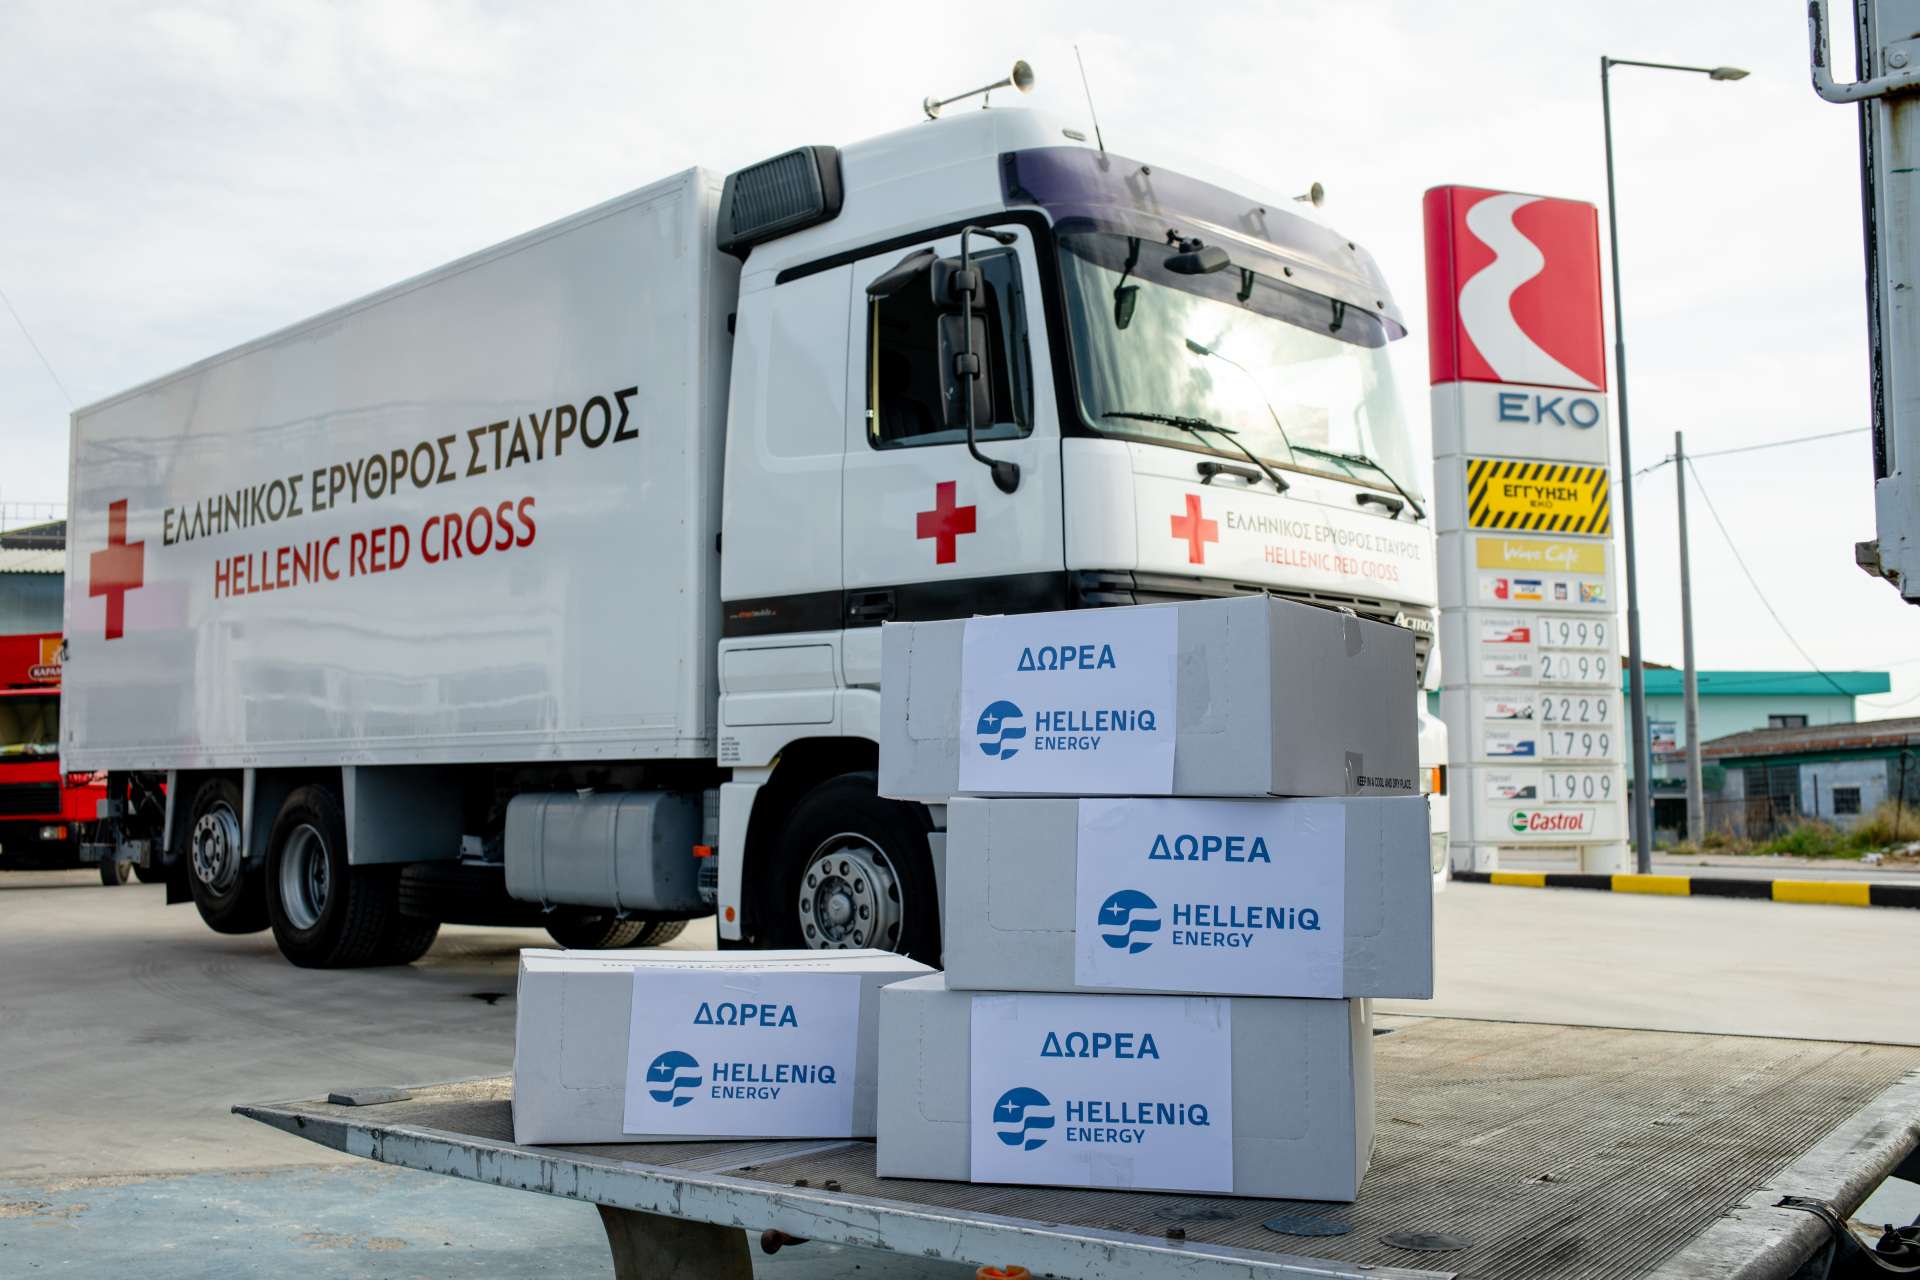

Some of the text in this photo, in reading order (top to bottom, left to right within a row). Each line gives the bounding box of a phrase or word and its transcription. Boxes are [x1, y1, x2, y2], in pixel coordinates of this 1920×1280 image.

[1499, 392, 1599, 429] EKO
[163, 385, 640, 547] ΕΛΛΗΝΙΚΟΣ ΕΡΥΘΡΟΣ ΣΤΑΥΡΟΣ
[1503, 484, 1578, 502] ΕΓΓΥΗΣΗ
[214, 494, 537, 600] HELLENIC RED CROSS
[1227, 511, 1421, 561] ΕΛΛΗΝΙΚΟΣ ΕΡΥΘΡΟΣ ΣΤΑΥΡΟΣ
[1264, 545, 1399, 582] HELLENIC RED CROSS
[1017, 644, 1116, 672] ΔΩΡΕΑ
[1035, 710, 1157, 732] HELLENiQ
[1034, 736, 1101, 751] ENERGY
[1357, 776, 1366, 786] KEEP
[1375, 777, 1384, 788] COOL
[1530, 813, 1583, 831] Castrol
[1148, 834, 1271, 863] ΔΩΡΕΑ
[1172, 904, 1321, 931] HELLENiQ
[1172, 932, 1254, 948] ENERGY
[693, 1002, 798, 1028] ΔΩΡΕΑ
[1040, 1031, 1160, 1060] ΔΩΡΕΑ
[712, 1063, 836, 1084] HELLENiQ
[711, 1086, 781, 1100] ENERGY
[1066, 1101, 1210, 1127] HELLENiQ
[1066, 1128, 1145, 1144] ENERGY
